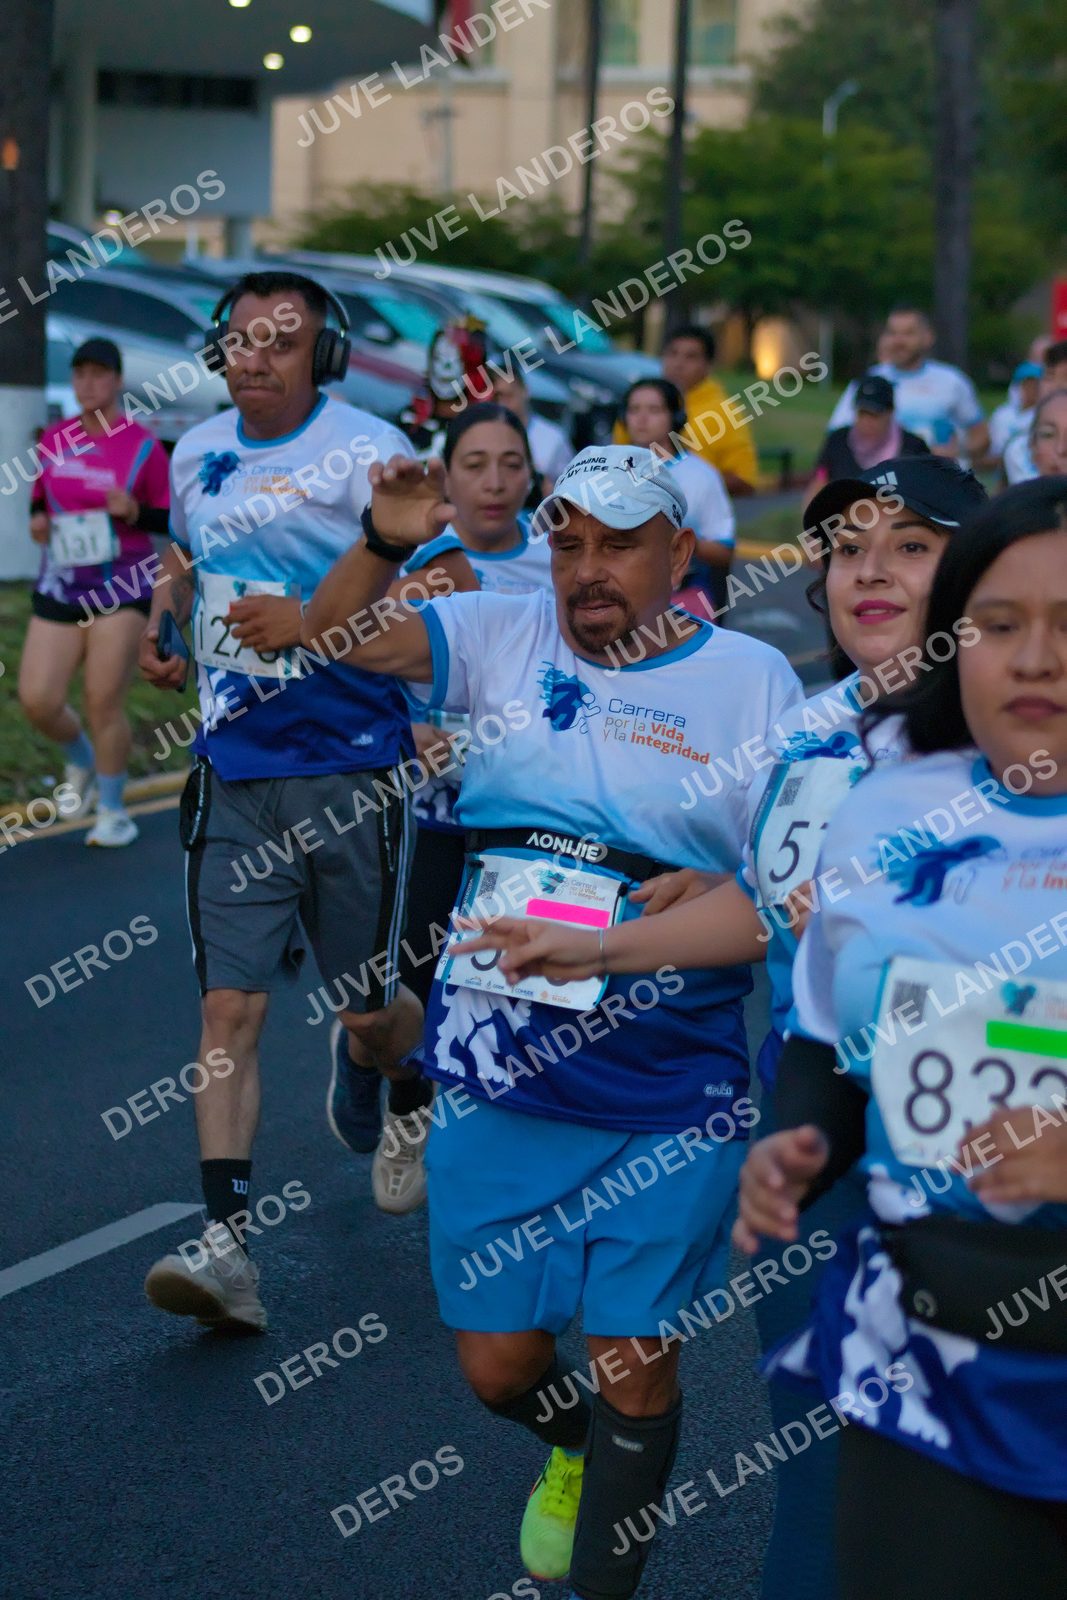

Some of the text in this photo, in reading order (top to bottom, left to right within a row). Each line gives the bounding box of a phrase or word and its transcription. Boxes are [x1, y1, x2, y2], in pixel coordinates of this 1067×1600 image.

[608, 698, 687, 729] Carrera
[603, 729, 611, 743] y
[614, 728, 627, 742] la
[604, 716, 685, 743] por la Vida
